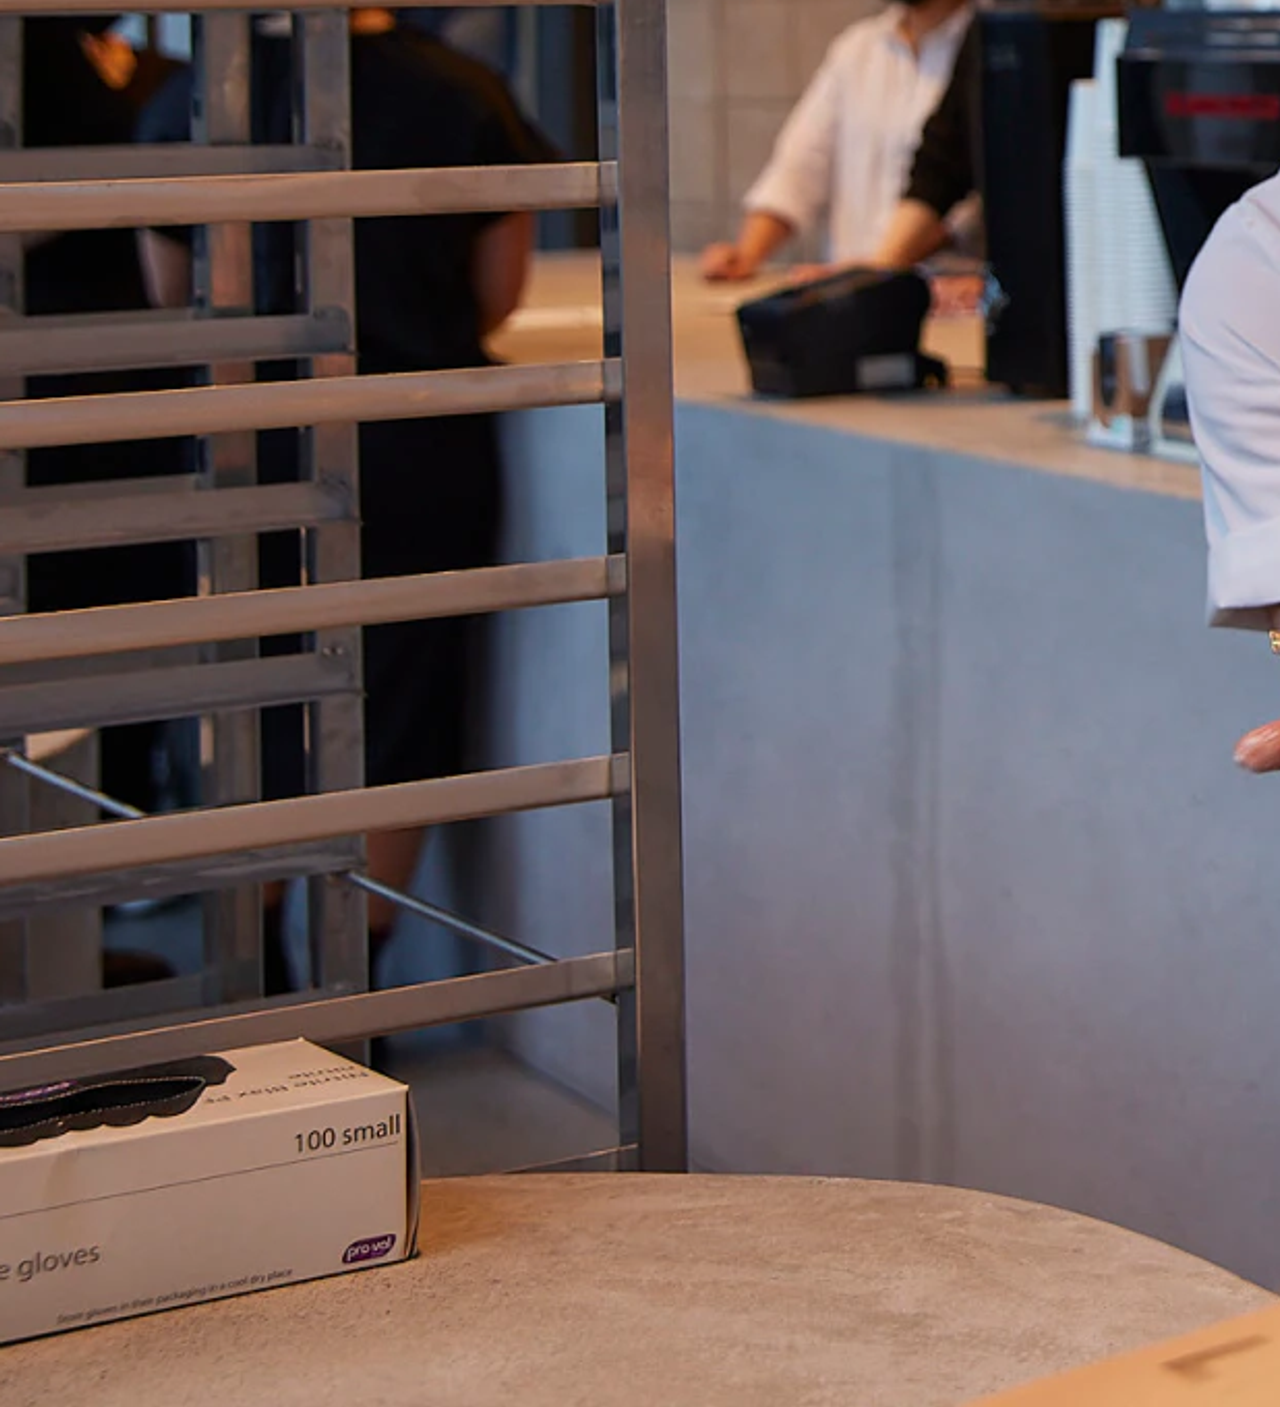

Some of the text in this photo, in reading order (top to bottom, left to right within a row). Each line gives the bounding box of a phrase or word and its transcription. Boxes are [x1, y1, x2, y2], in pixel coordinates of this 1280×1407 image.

[294, 1113, 400, 1153] 100 small
[17, 1245, 101, 1283] gloves
[156, 1286, 207, 1307] packaging
[227, 1275, 248, 1288] cool
[250, 1273, 267, 1284] dry
[267, 1268, 294, 1282] place
